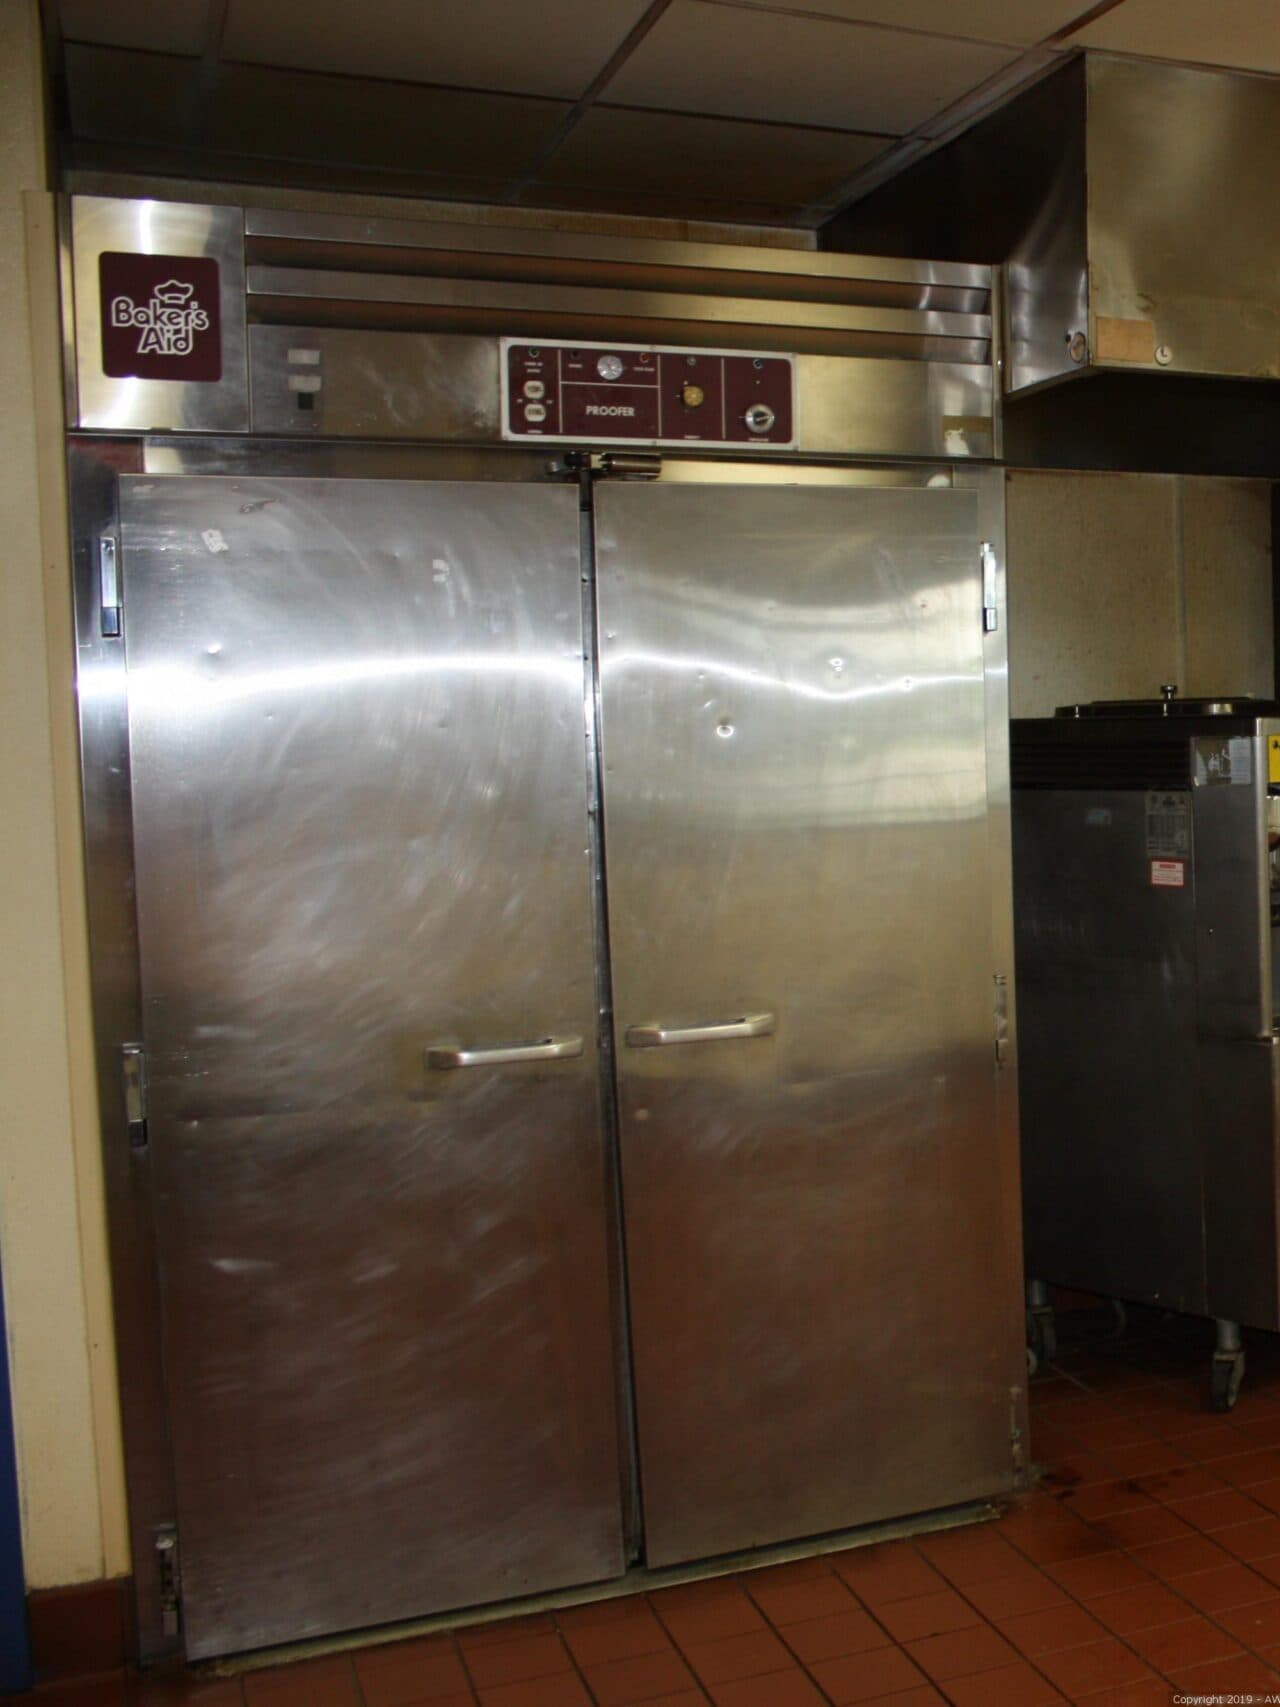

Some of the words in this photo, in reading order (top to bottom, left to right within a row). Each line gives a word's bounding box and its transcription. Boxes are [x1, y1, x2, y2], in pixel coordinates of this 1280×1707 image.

[112, 297, 209, 330] Baker's
[137, 326, 193, 355] Aid
[586, 405, 636, 417] PROOFER
